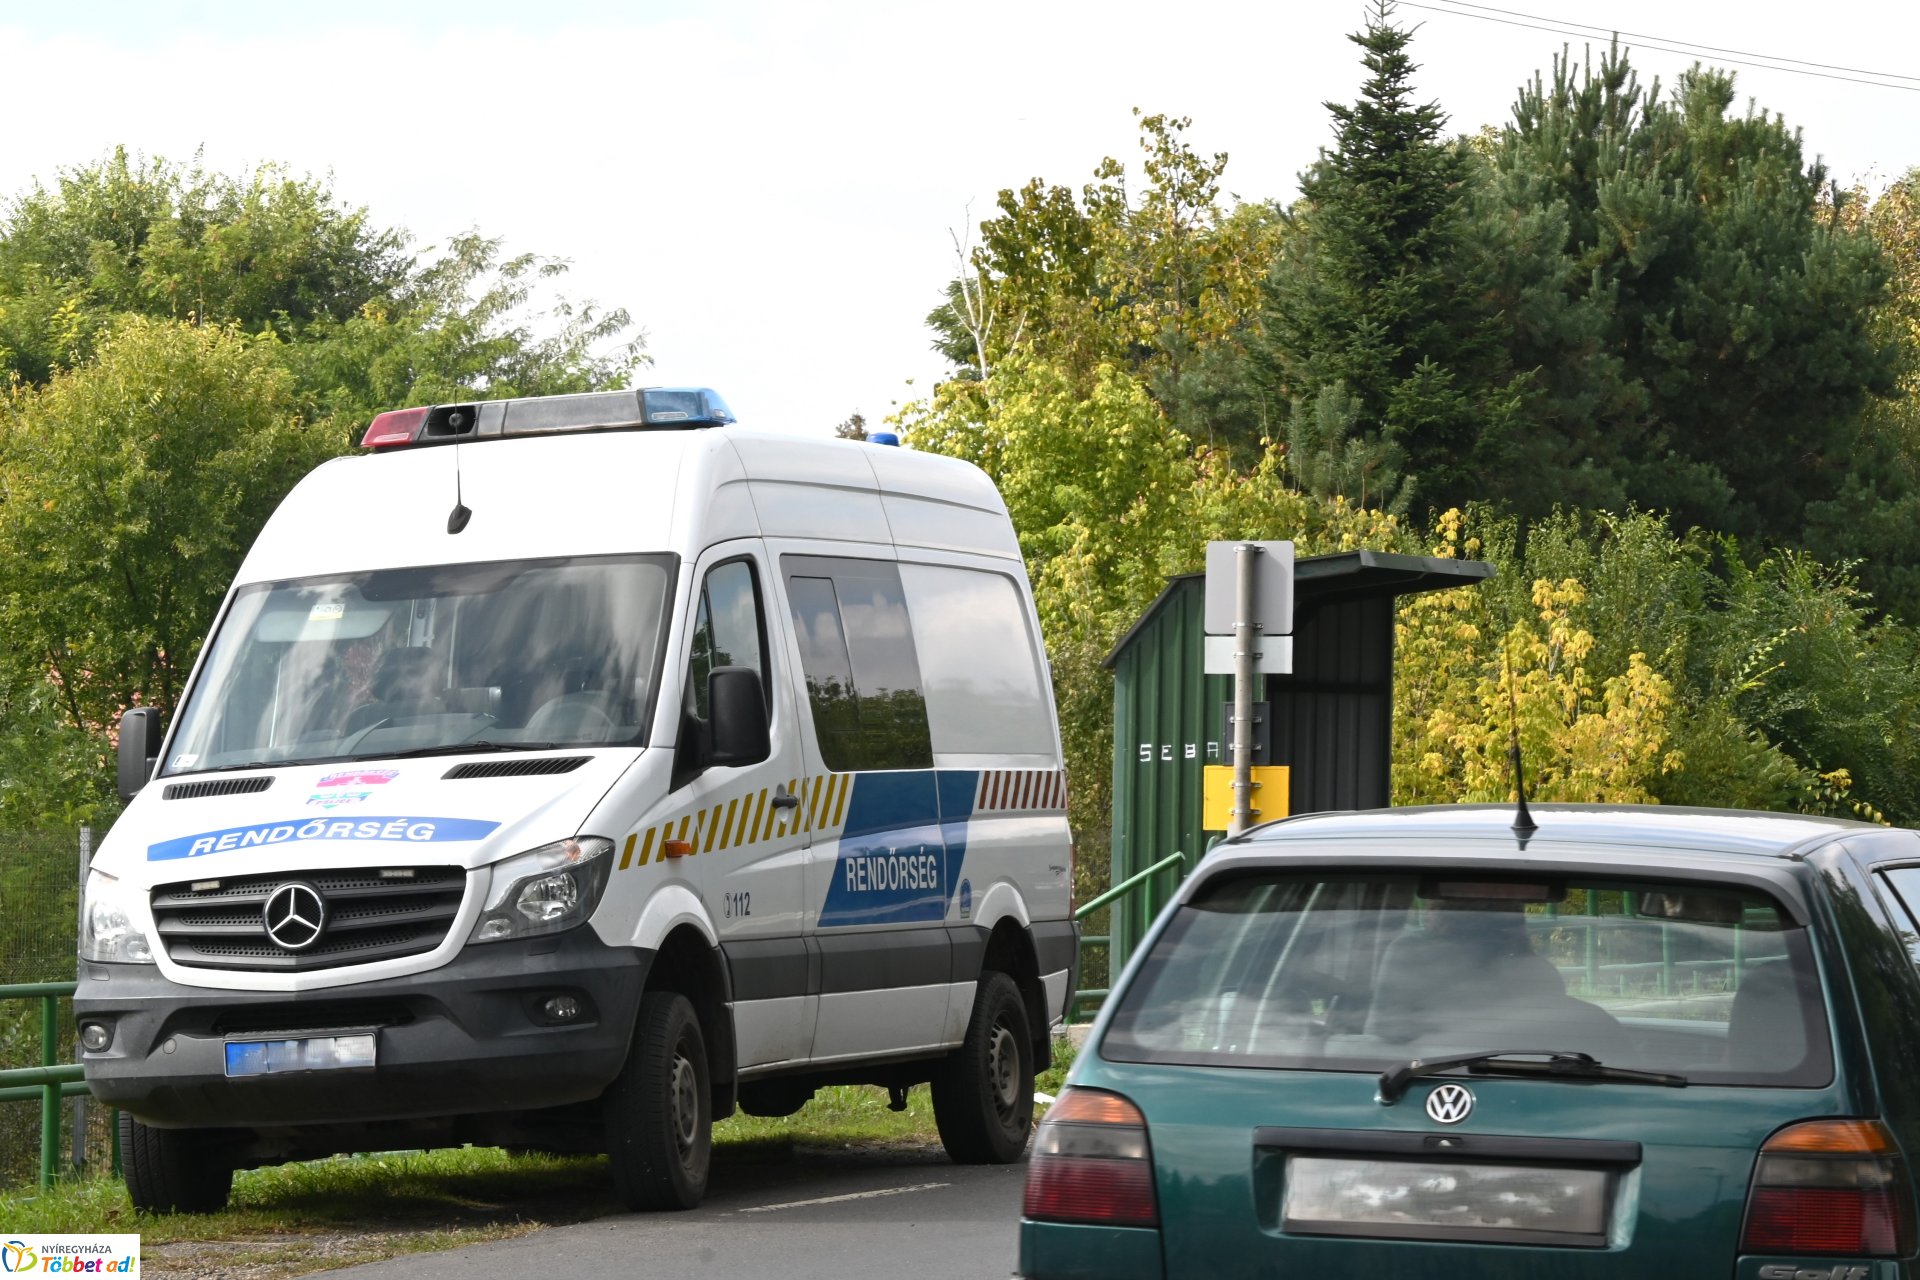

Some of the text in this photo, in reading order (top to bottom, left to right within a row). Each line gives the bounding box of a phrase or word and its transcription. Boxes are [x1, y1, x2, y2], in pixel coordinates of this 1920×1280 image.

[1139, 741, 1219, 762] SEBA
[188, 818, 436, 857] RENDŐRSÉG
[845, 847, 938, 892] RENDŐRSÉG
[733, 891, 751, 917] 112
[1758, 1265, 1870, 1280] Golf
